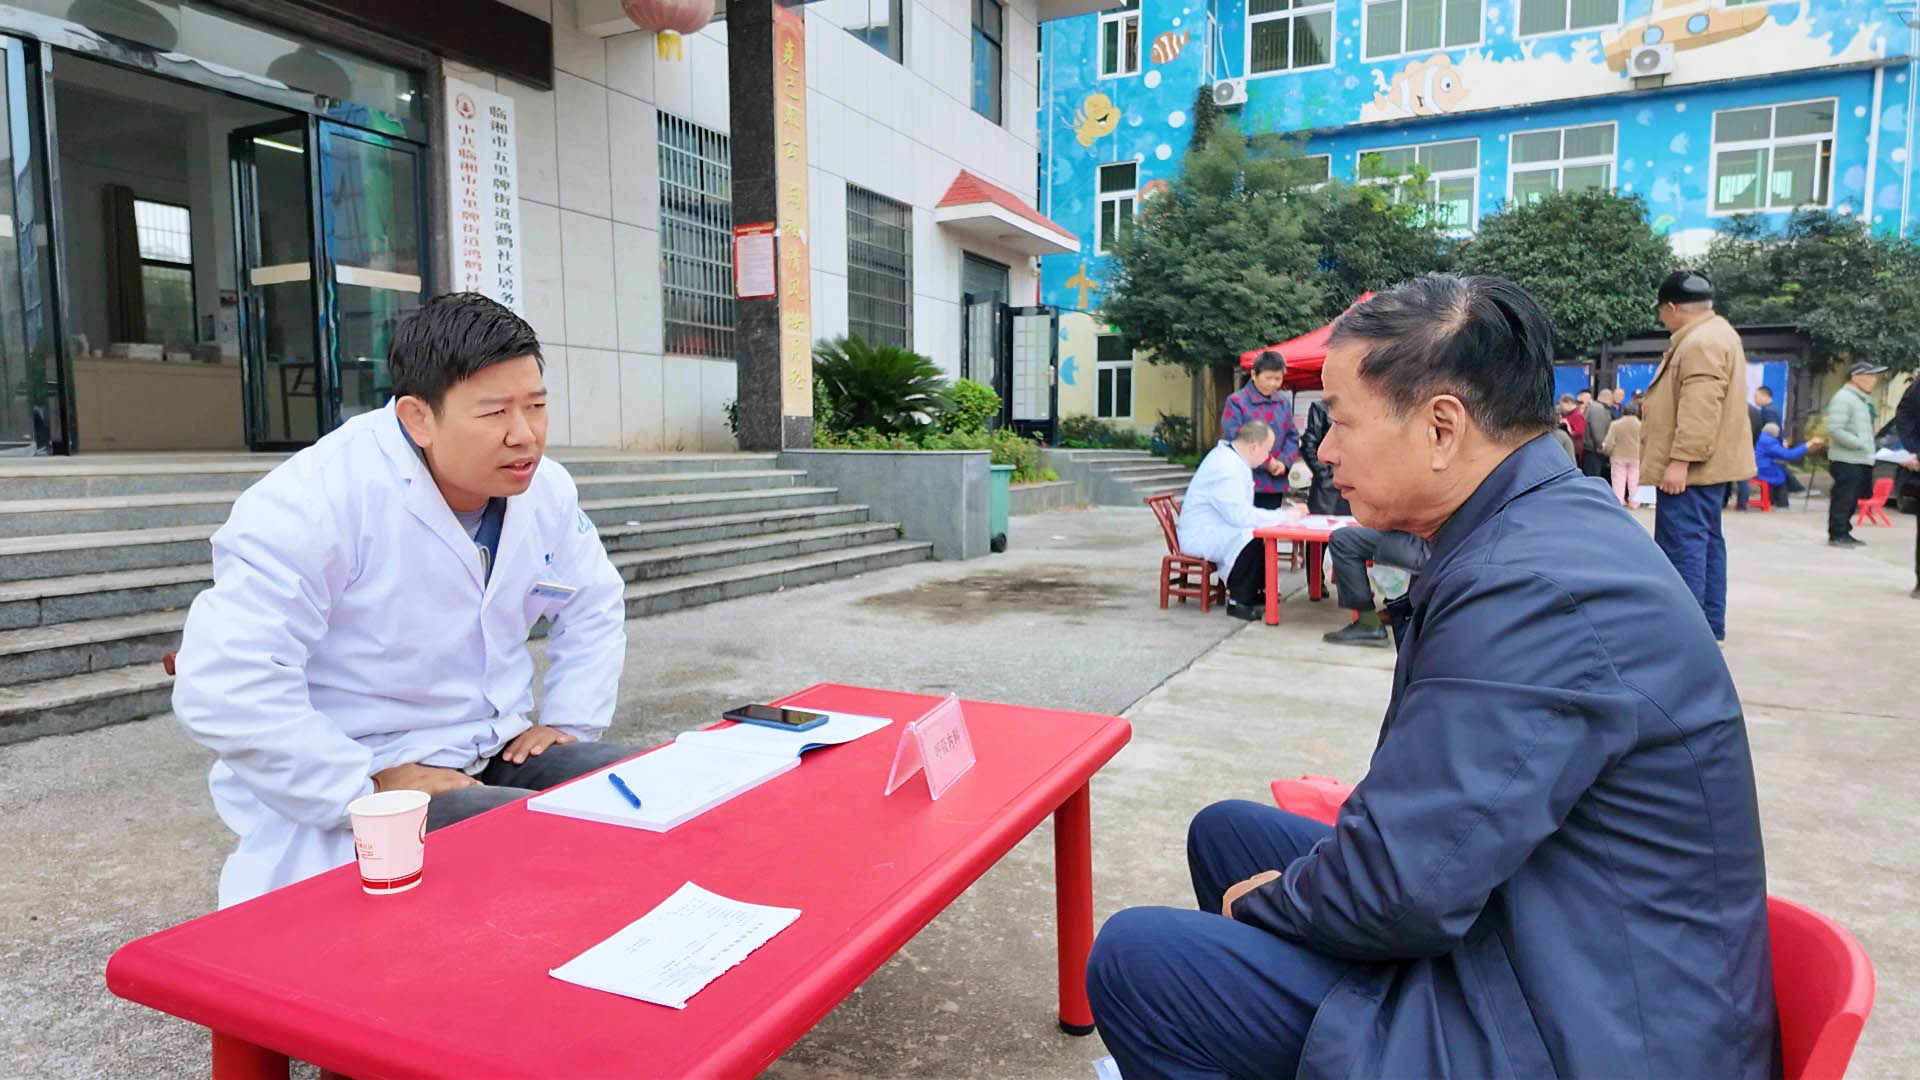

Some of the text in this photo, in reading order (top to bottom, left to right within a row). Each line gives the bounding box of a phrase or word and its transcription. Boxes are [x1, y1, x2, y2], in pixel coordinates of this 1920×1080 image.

[489, 105, 515, 309] 临湘市五里牌街道鸿鹤社区居务
